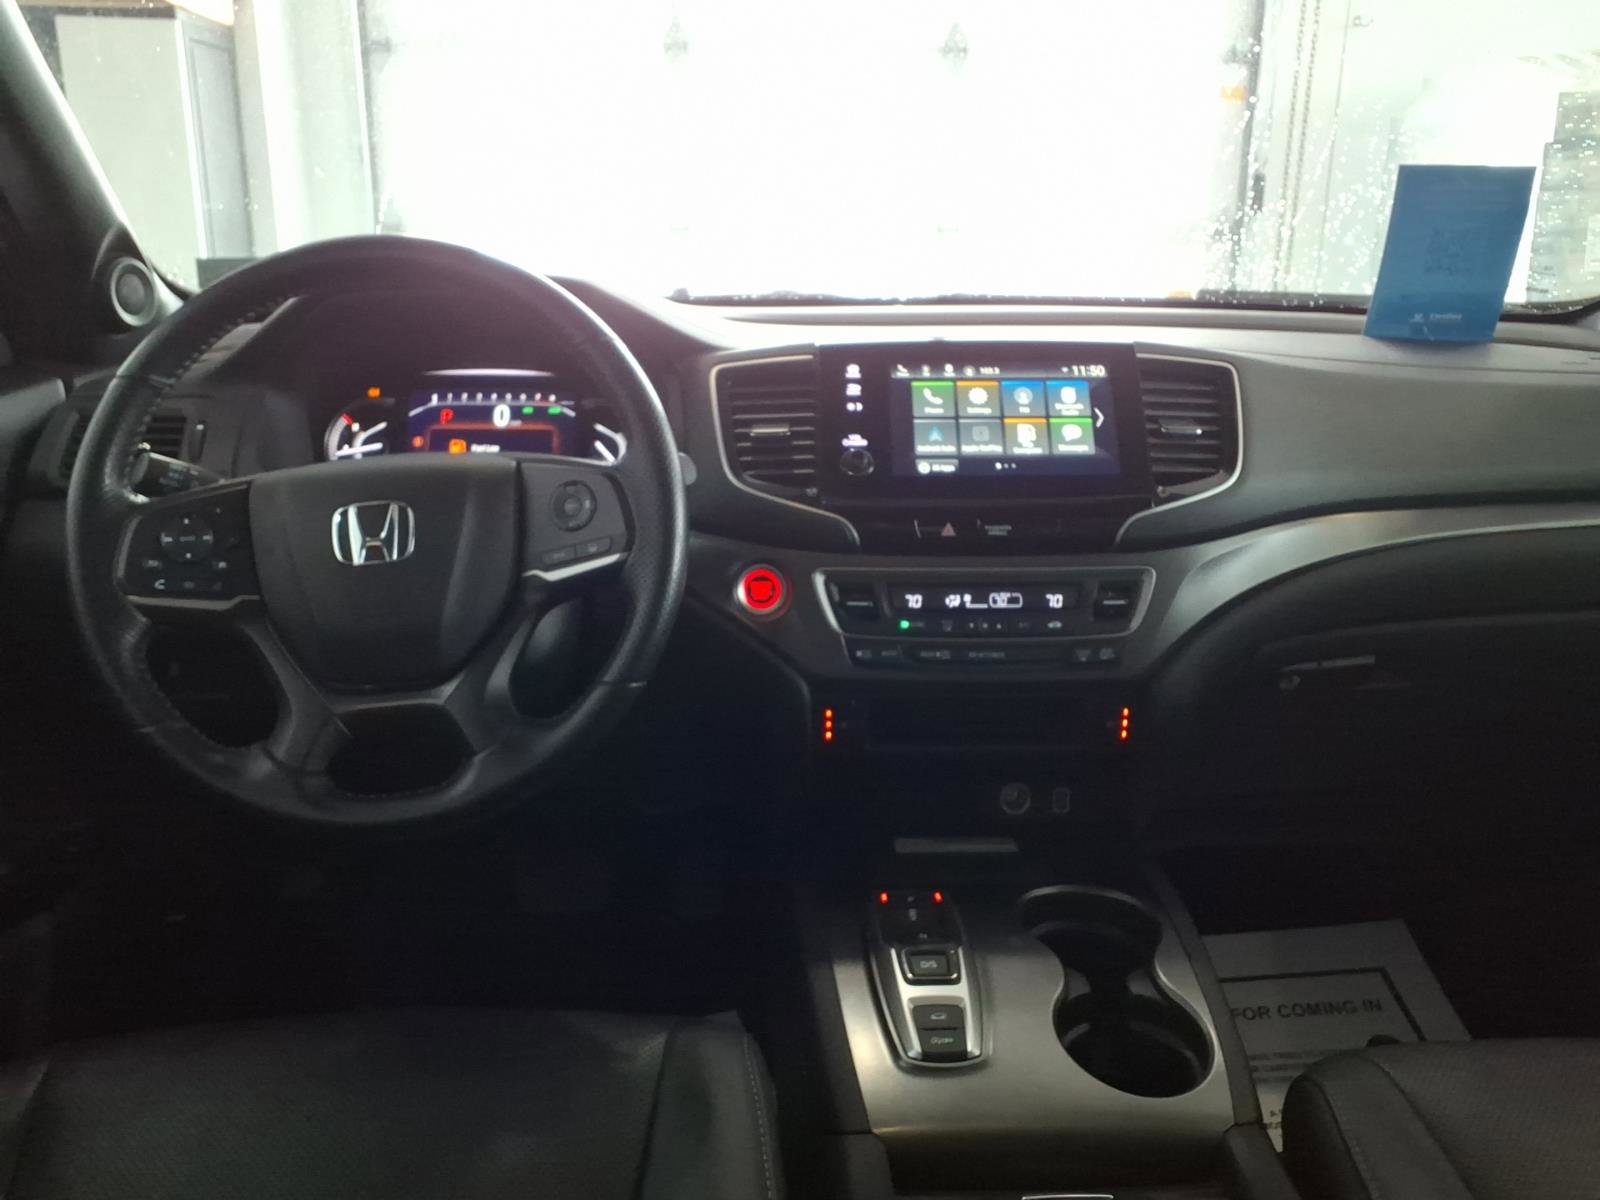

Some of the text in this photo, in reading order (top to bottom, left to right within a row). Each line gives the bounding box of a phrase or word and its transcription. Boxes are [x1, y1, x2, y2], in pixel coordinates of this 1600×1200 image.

[1071, 364, 1106, 377] 11:50
[440, 408, 454, 425] P
[905, 594, 923, 609] 70
[1045, 594, 1064, 609] 70
[1230, 999, 1383, 1021] FOR COMING IN
